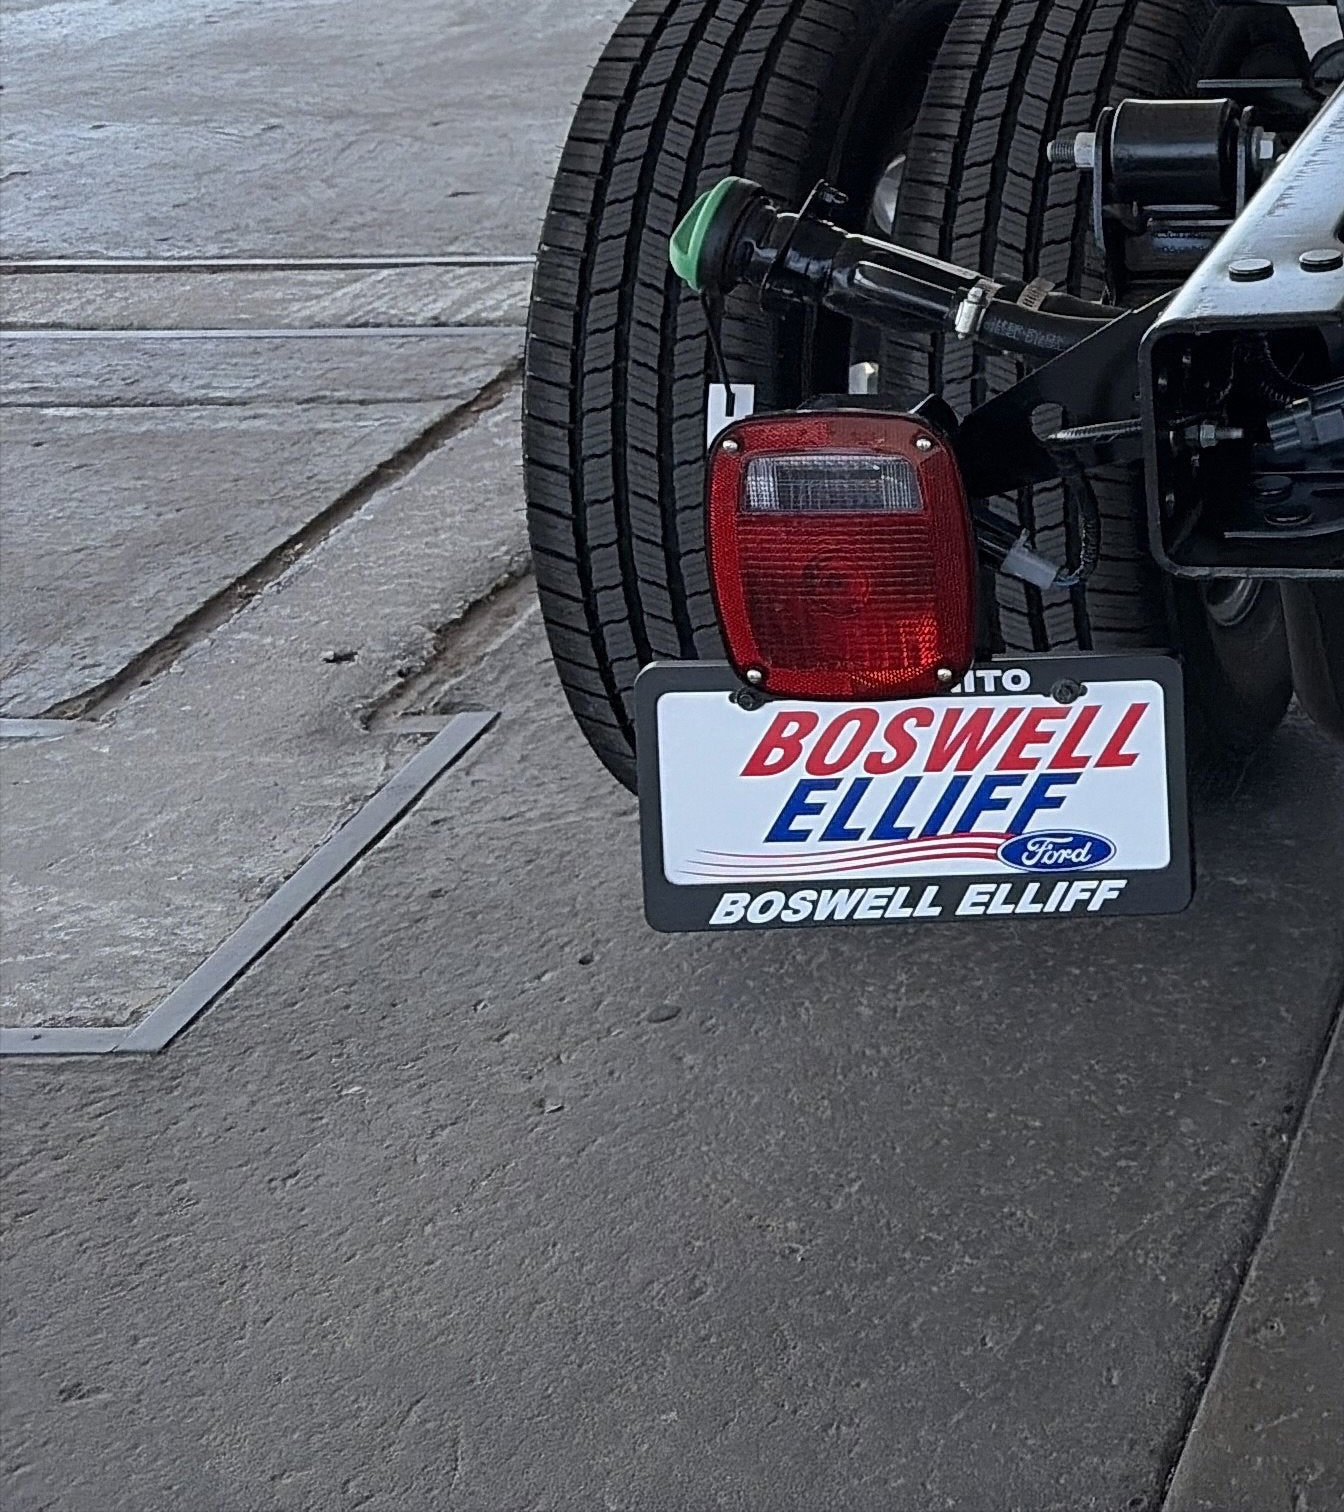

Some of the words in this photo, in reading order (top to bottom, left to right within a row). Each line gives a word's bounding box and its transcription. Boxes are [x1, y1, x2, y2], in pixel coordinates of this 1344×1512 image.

[740, 702, 1150, 777] BOSWELL
[764, 772, 1083, 843] ELLIFF
[1021, 836, 1093, 865] Ford
[708, 886, 942, 925] BOSWELL
[955, 879, 1128, 916] ELLIFF
